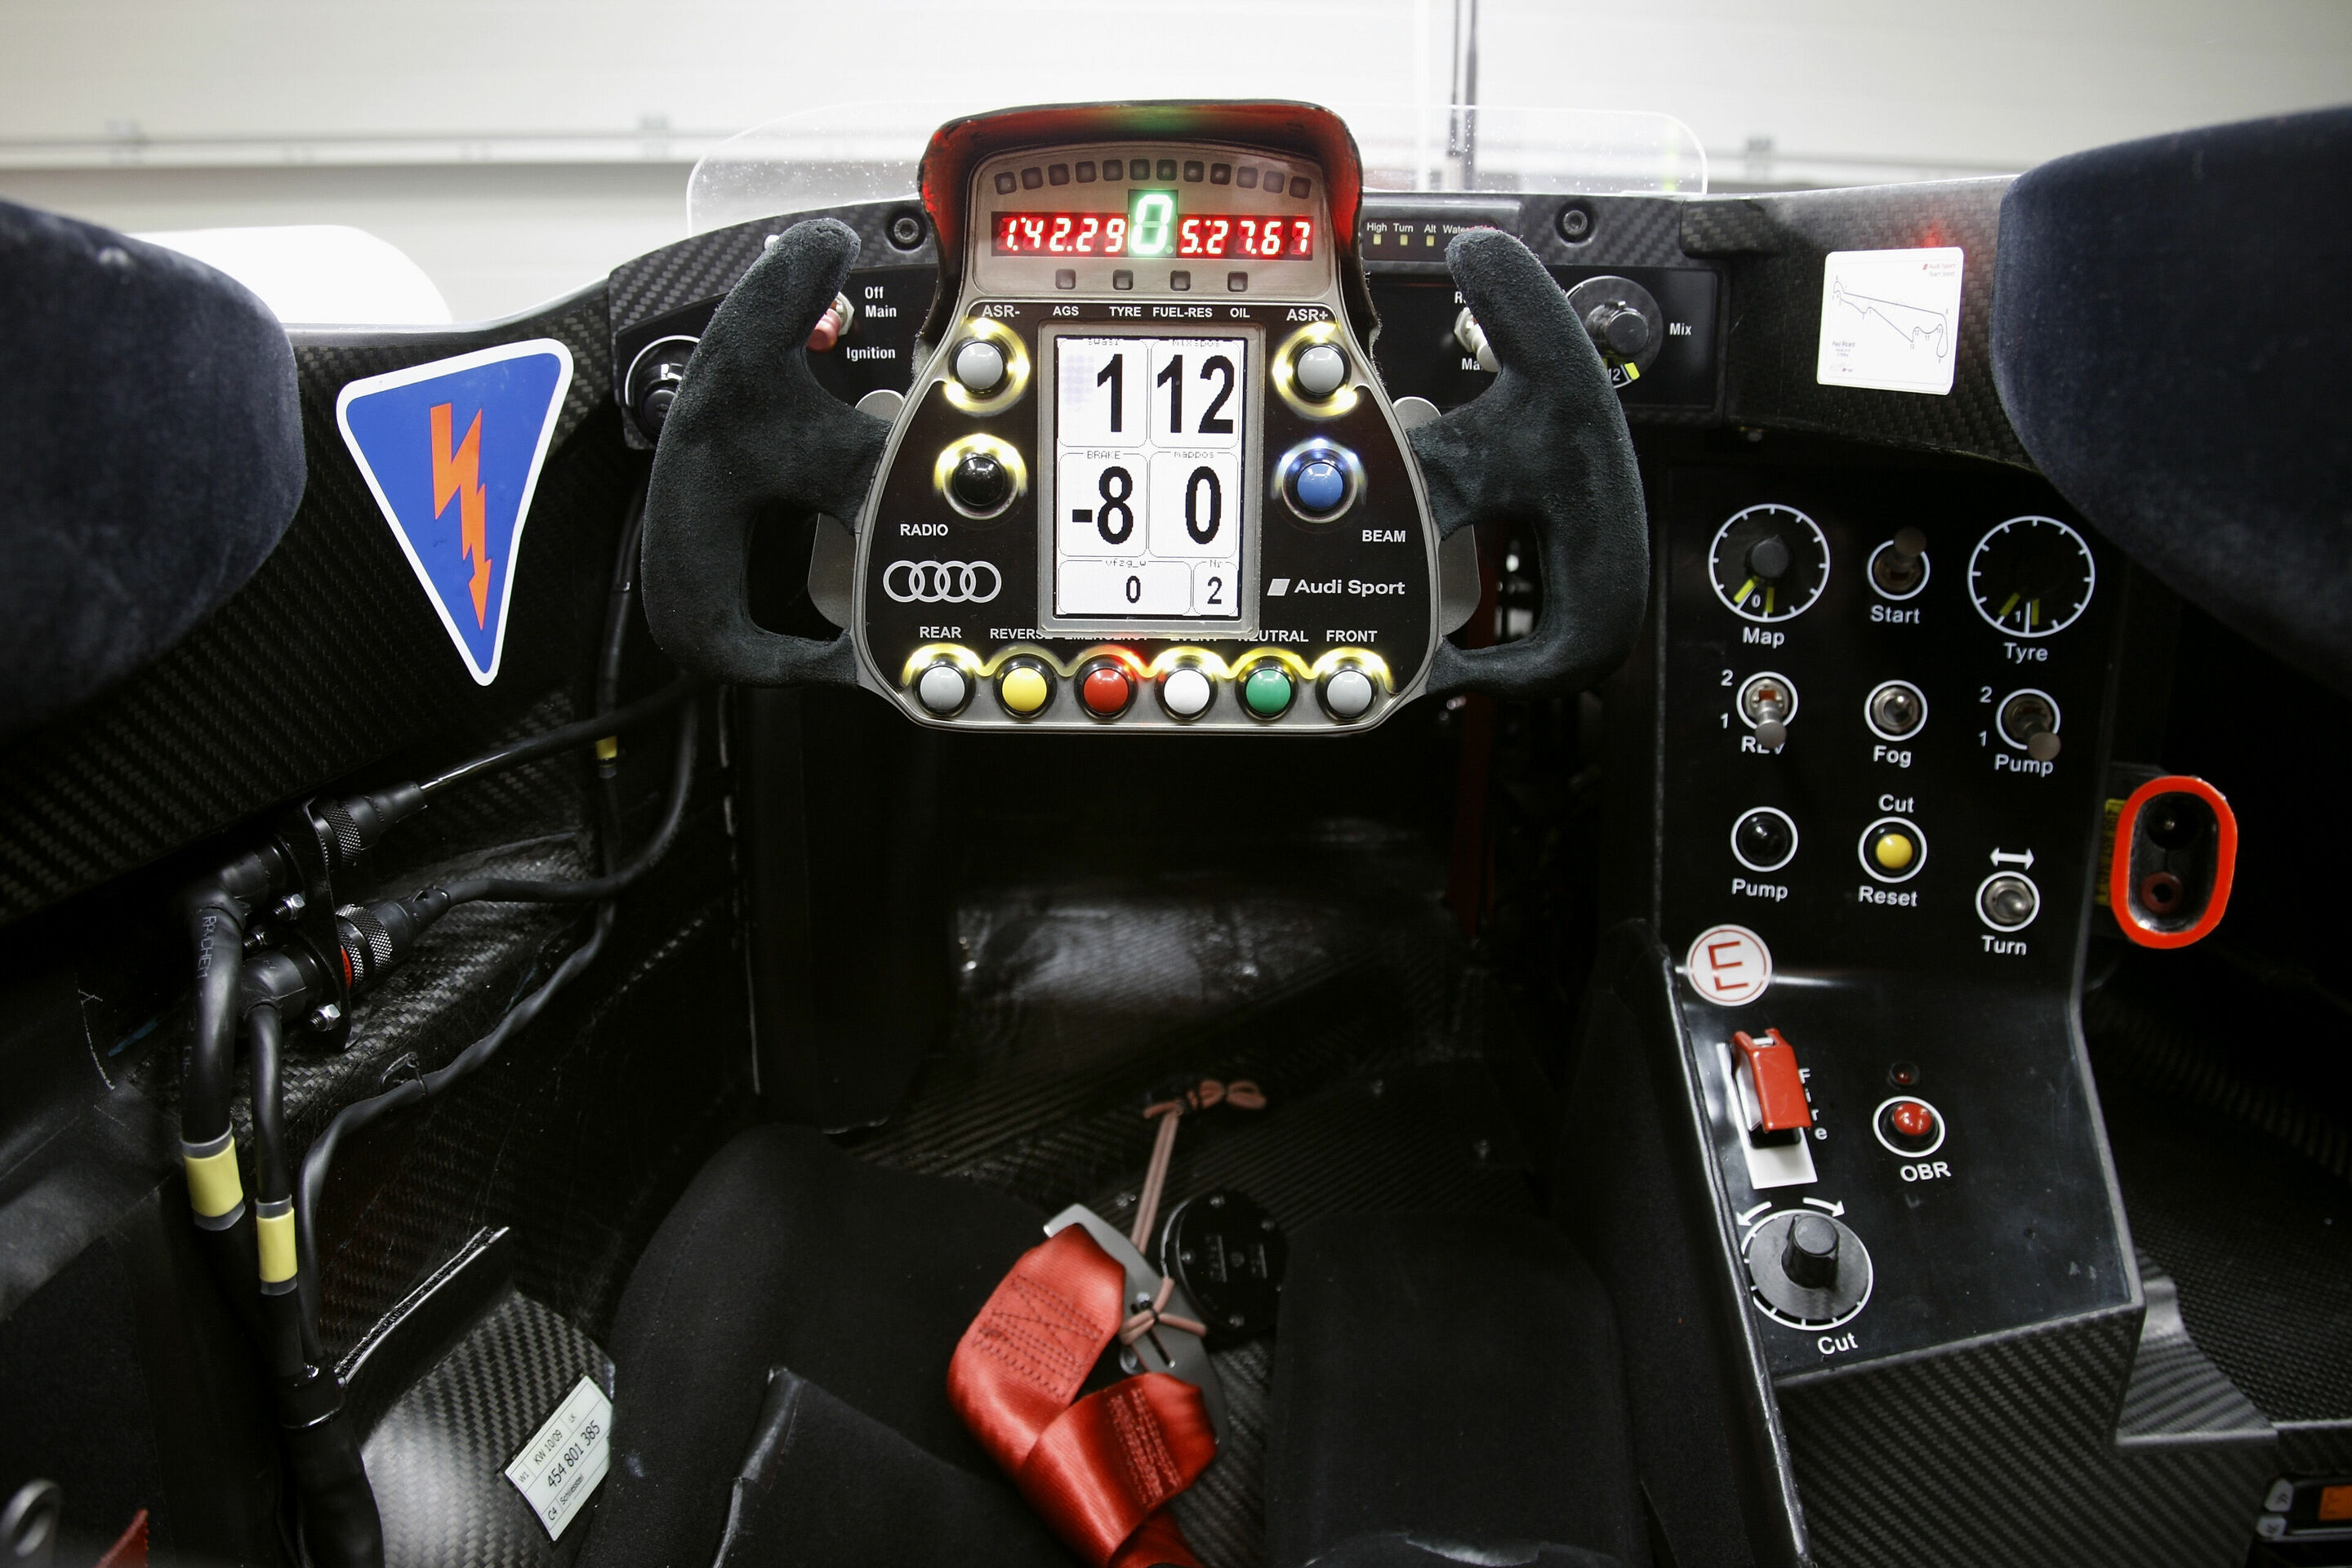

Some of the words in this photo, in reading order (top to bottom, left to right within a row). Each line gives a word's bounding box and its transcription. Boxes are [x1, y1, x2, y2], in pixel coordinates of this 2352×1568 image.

[1131, 194, 1173, 254] 0
[1366, 221, 1388, 234] High
[1392, 222, 1414, 234] Turn
[1423, 224, 1437, 234] Alt
[864, 286, 884, 300] Off
[865, 305, 897, 318] Main
[982, 304, 1021, 318] ASR-
[1052, 305, 1080, 317] AGS
[1108, 306, 1142, 317] TYRE
[1152, 306, 1214, 318] FUEL-RES
[1230, 307, 1250, 318] OIL
[1286, 308, 1329, 322] ASR+
[1669, 323, 1692, 336] Mix
[846, 346, 896, 362] Ignition
[1098, 354, 1123, 433] 1
[1156, 354, 1235, 434] 12
[1087, 450, 1121, 460] BRAKE
[1174, 450, 1215, 459] mappos
[1072, 466, 1134, 545] -8
[1185, 466, 1222, 545] 0
[900, 523, 949, 537] RADIO
[1362, 529, 1406, 542] BEAM
[1125, 575, 1141, 604] 0
[1207, 576, 1223, 605] 2
[1294, 579, 1342, 594] Audi
[1348, 579, 1405, 598] Sport
[1870, 604, 1921, 625] Start
[920, 626, 962, 639] REAR
[990, 628, 1054, 640] REVERS
[1238, 630, 1309, 643] UTRAL
[1326, 630, 1379, 643] FRONT
[1742, 626, 1785, 649] Map
[2004, 642, 2049, 663] Tyre
[1721, 669, 1734, 687] 2
[1980, 686, 1993, 703] 2
[1720, 712, 1729, 729] 1
[1980, 730, 1987, 747] 1
[1873, 745, 1913, 768] Fog
[1994, 754, 2054, 777] Pump
[1878, 794, 1915, 813] Cut
[1731, 878, 1788, 902] Pump
[1858, 884, 1918, 907] Reset
[1981, 934, 2027, 956] Turn
[1900, 1161, 1952, 1183] OBR
[1817, 1332, 1859, 1356] Cut
[534, 1448, 546, 1466] KW
[544, 1429, 564, 1452] 10/09
[547, 1462, 568, 1489] 454
[564, 1442, 585, 1468] 801
[580, 1419, 601, 1446] 385
[547, 1506, 559, 1521] C4
